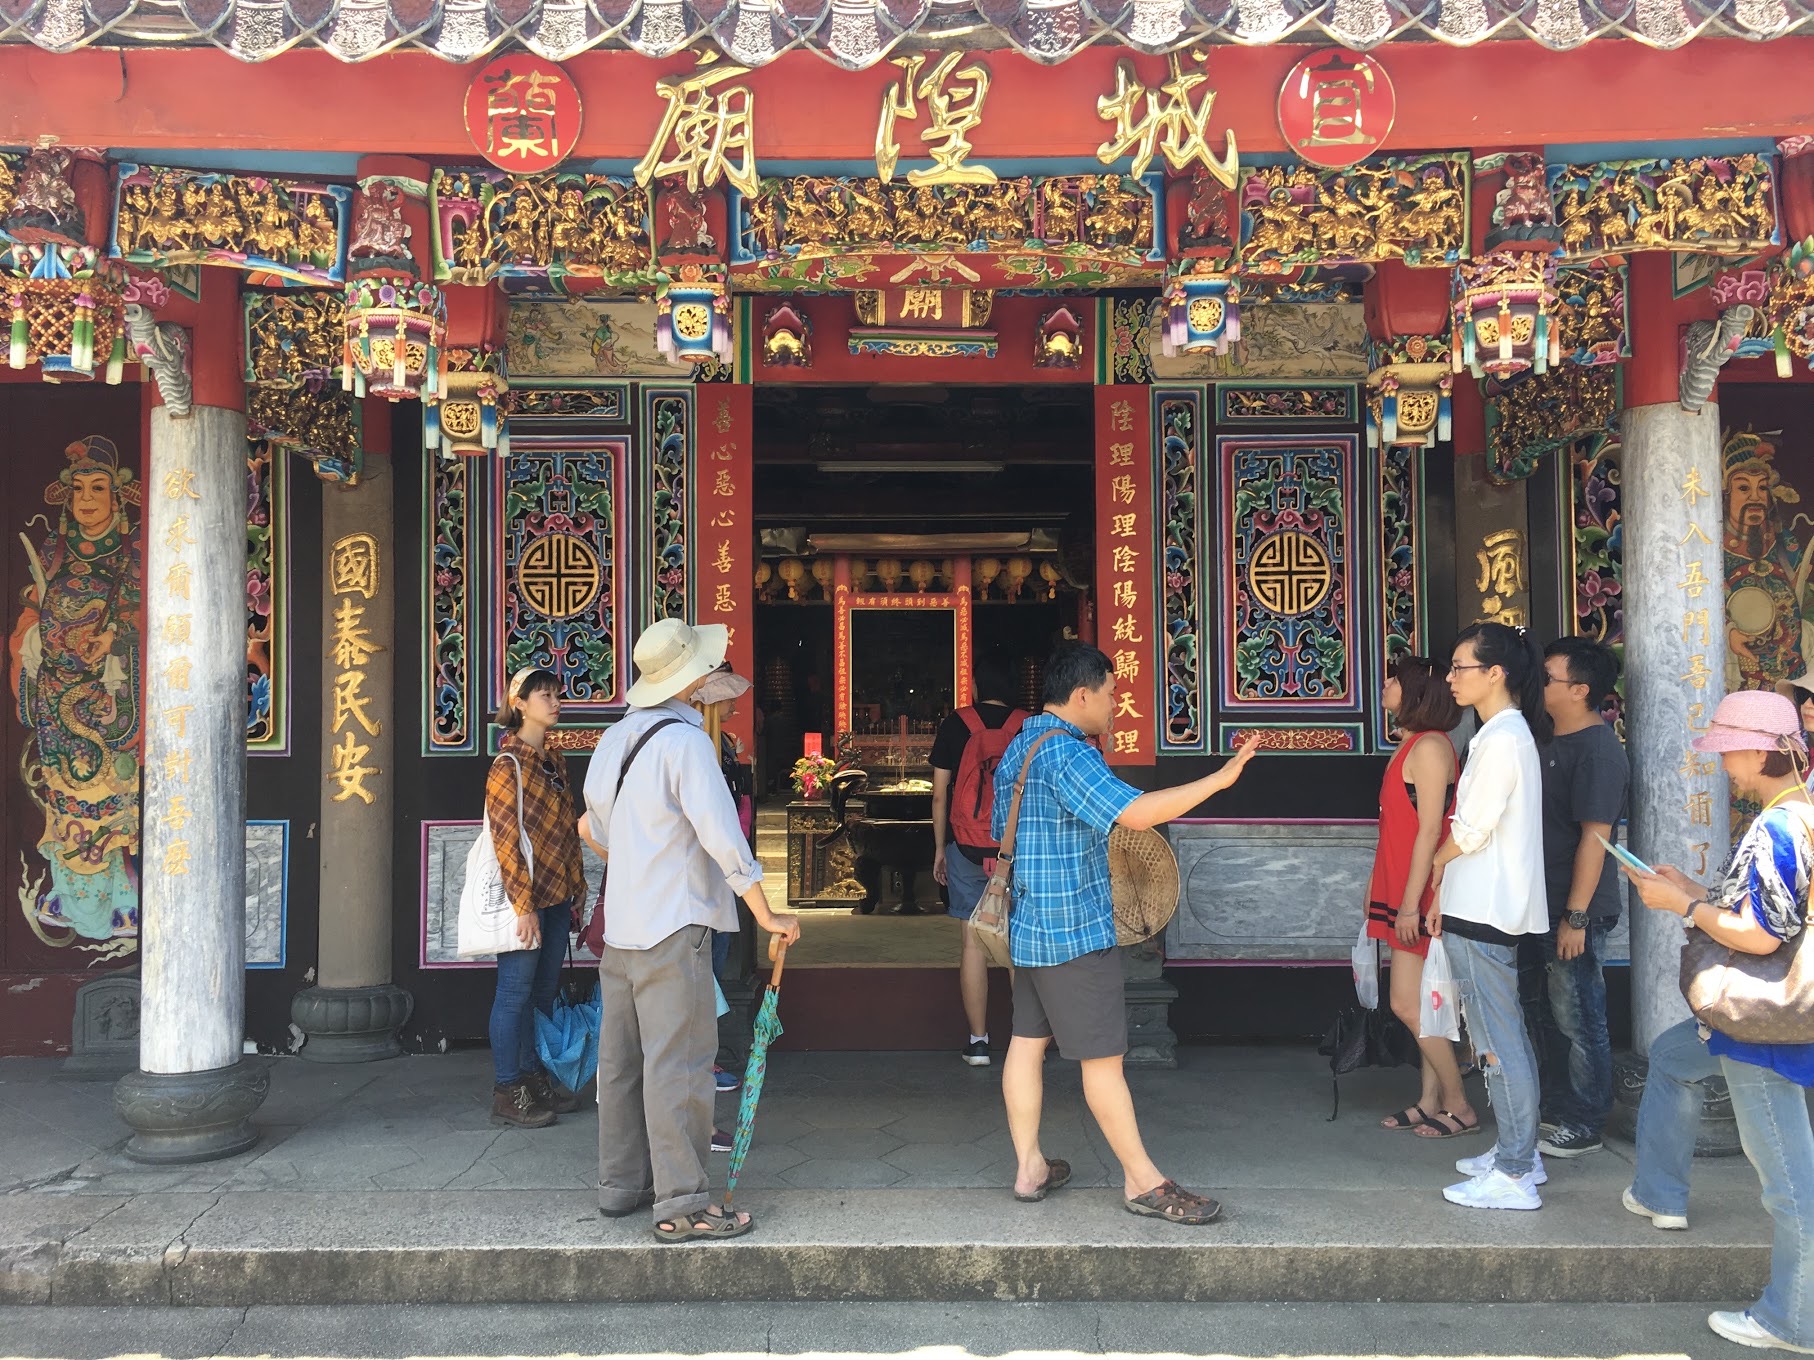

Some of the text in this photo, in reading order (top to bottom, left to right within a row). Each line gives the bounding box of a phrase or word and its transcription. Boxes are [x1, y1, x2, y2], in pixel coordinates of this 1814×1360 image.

[484, 68, 562, 158] 蘭
[1298, 53, 1377, 147] 宜
[326, 531, 387, 805] 國泰民安
[1109, 399, 1143, 754] 陰理陽理陰陽統歸天理
